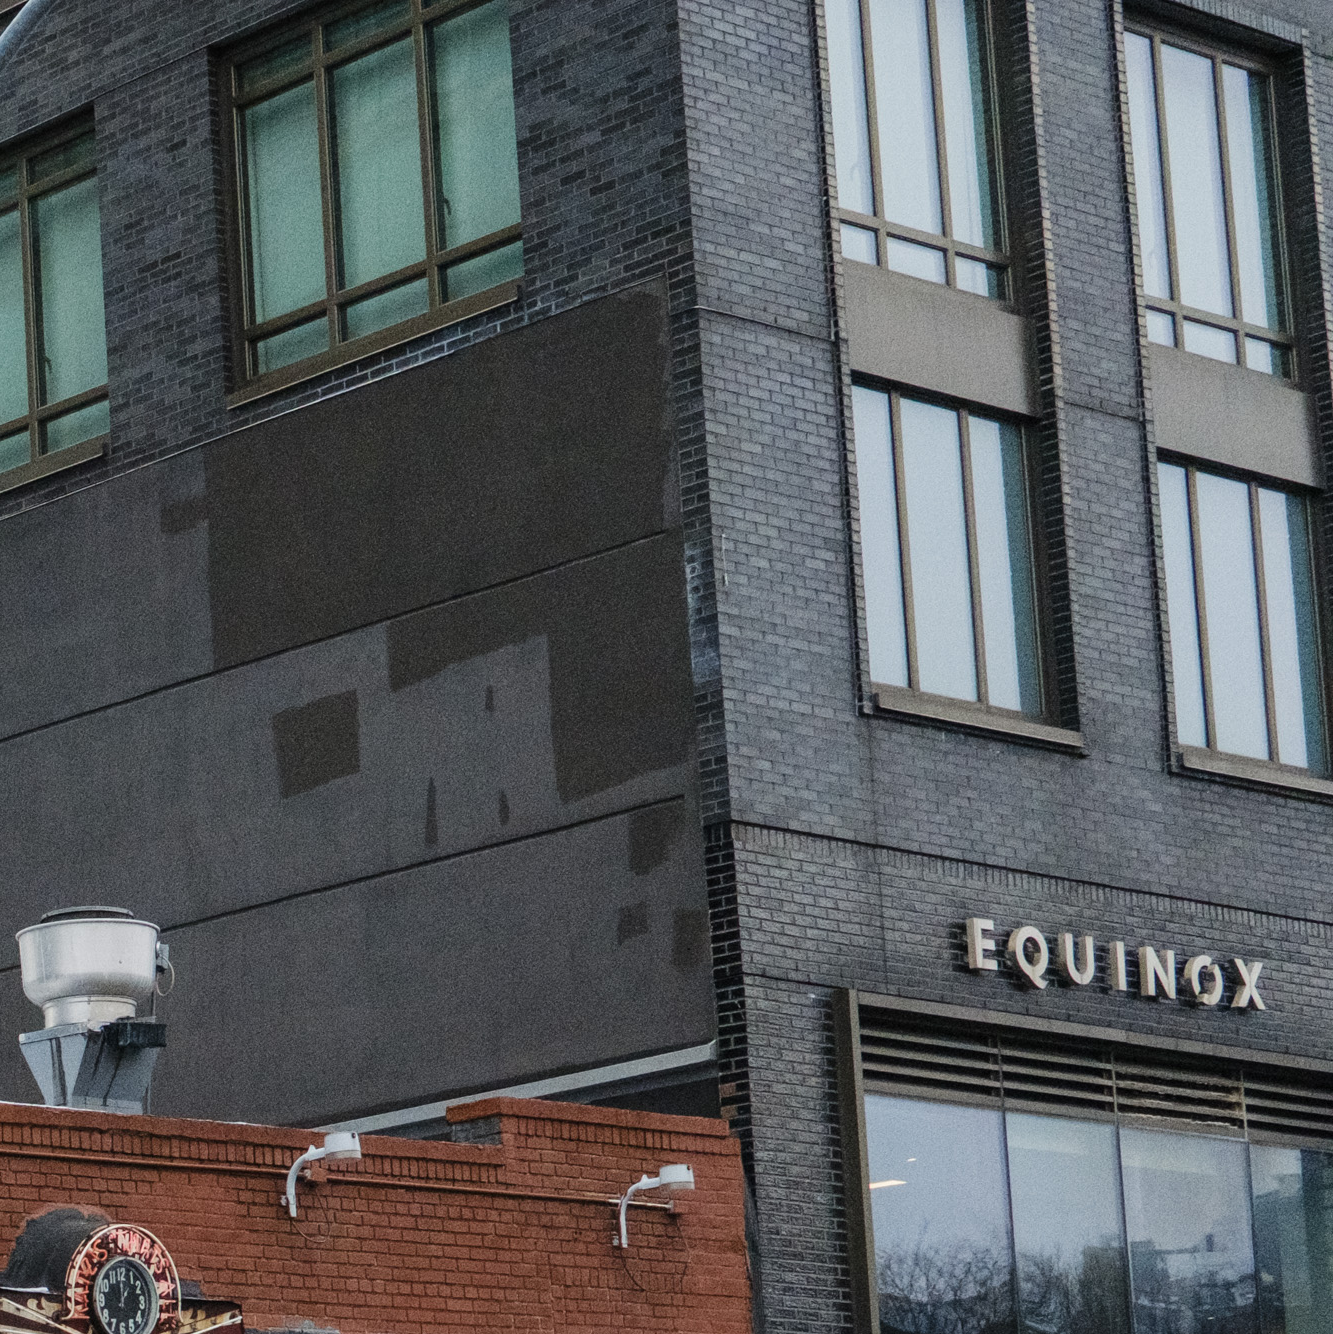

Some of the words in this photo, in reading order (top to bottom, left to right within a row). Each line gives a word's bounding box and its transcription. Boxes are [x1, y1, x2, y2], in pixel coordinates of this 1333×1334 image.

[966, 917, 1267, 1011] EQUINOX
[109, 1270, 116, 1284] 11
[116, 1268, 126, 1281] 12
[129, 1271, 134, 1284] 1
[99, 1279, 109, 1293] 10
[135, 1280, 141, 1294] 2
[99, 1293, 105, 1307] 9
[139, 1295, 145, 1310] 3
[102, 1309, 109, 1323] 8
[135, 1310, 142, 1324] 4
[111, 1318, 117, 1331] 7
[128, 1319, 135, 1333] 5
